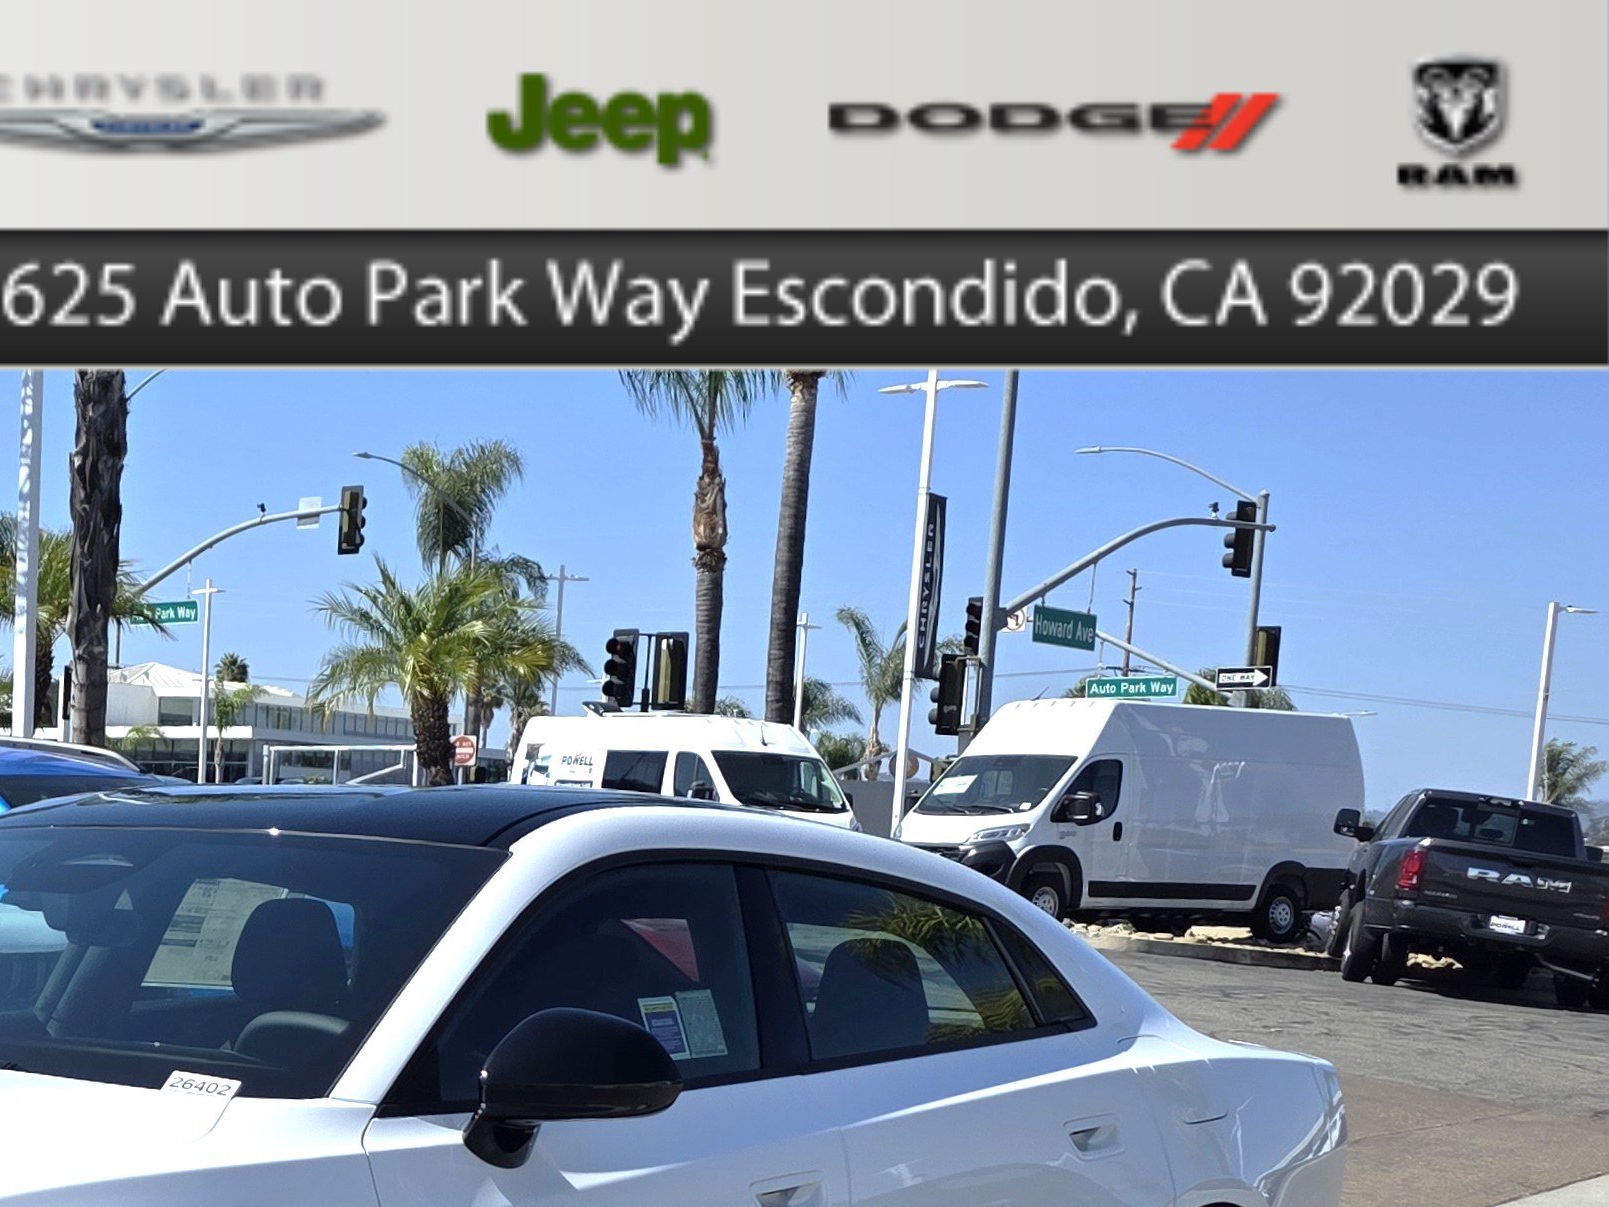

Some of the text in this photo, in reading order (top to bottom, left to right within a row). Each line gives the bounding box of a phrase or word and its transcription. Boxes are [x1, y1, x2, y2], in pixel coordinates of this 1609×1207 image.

[918, 523, 934, 648] CHRYSLER
[155, 607, 175, 620] Park
[177, 606, 196, 620] Way
[1034, 613, 1095, 643] Howard Ave
[1221, 674, 1237, 682] ONE
[1090, 681, 1174, 695] Auto Park Way
[561, 755, 593, 766] POWELL
[1467, 866, 1573, 894] RAM
[169, 1076, 232, 1097] 26402
